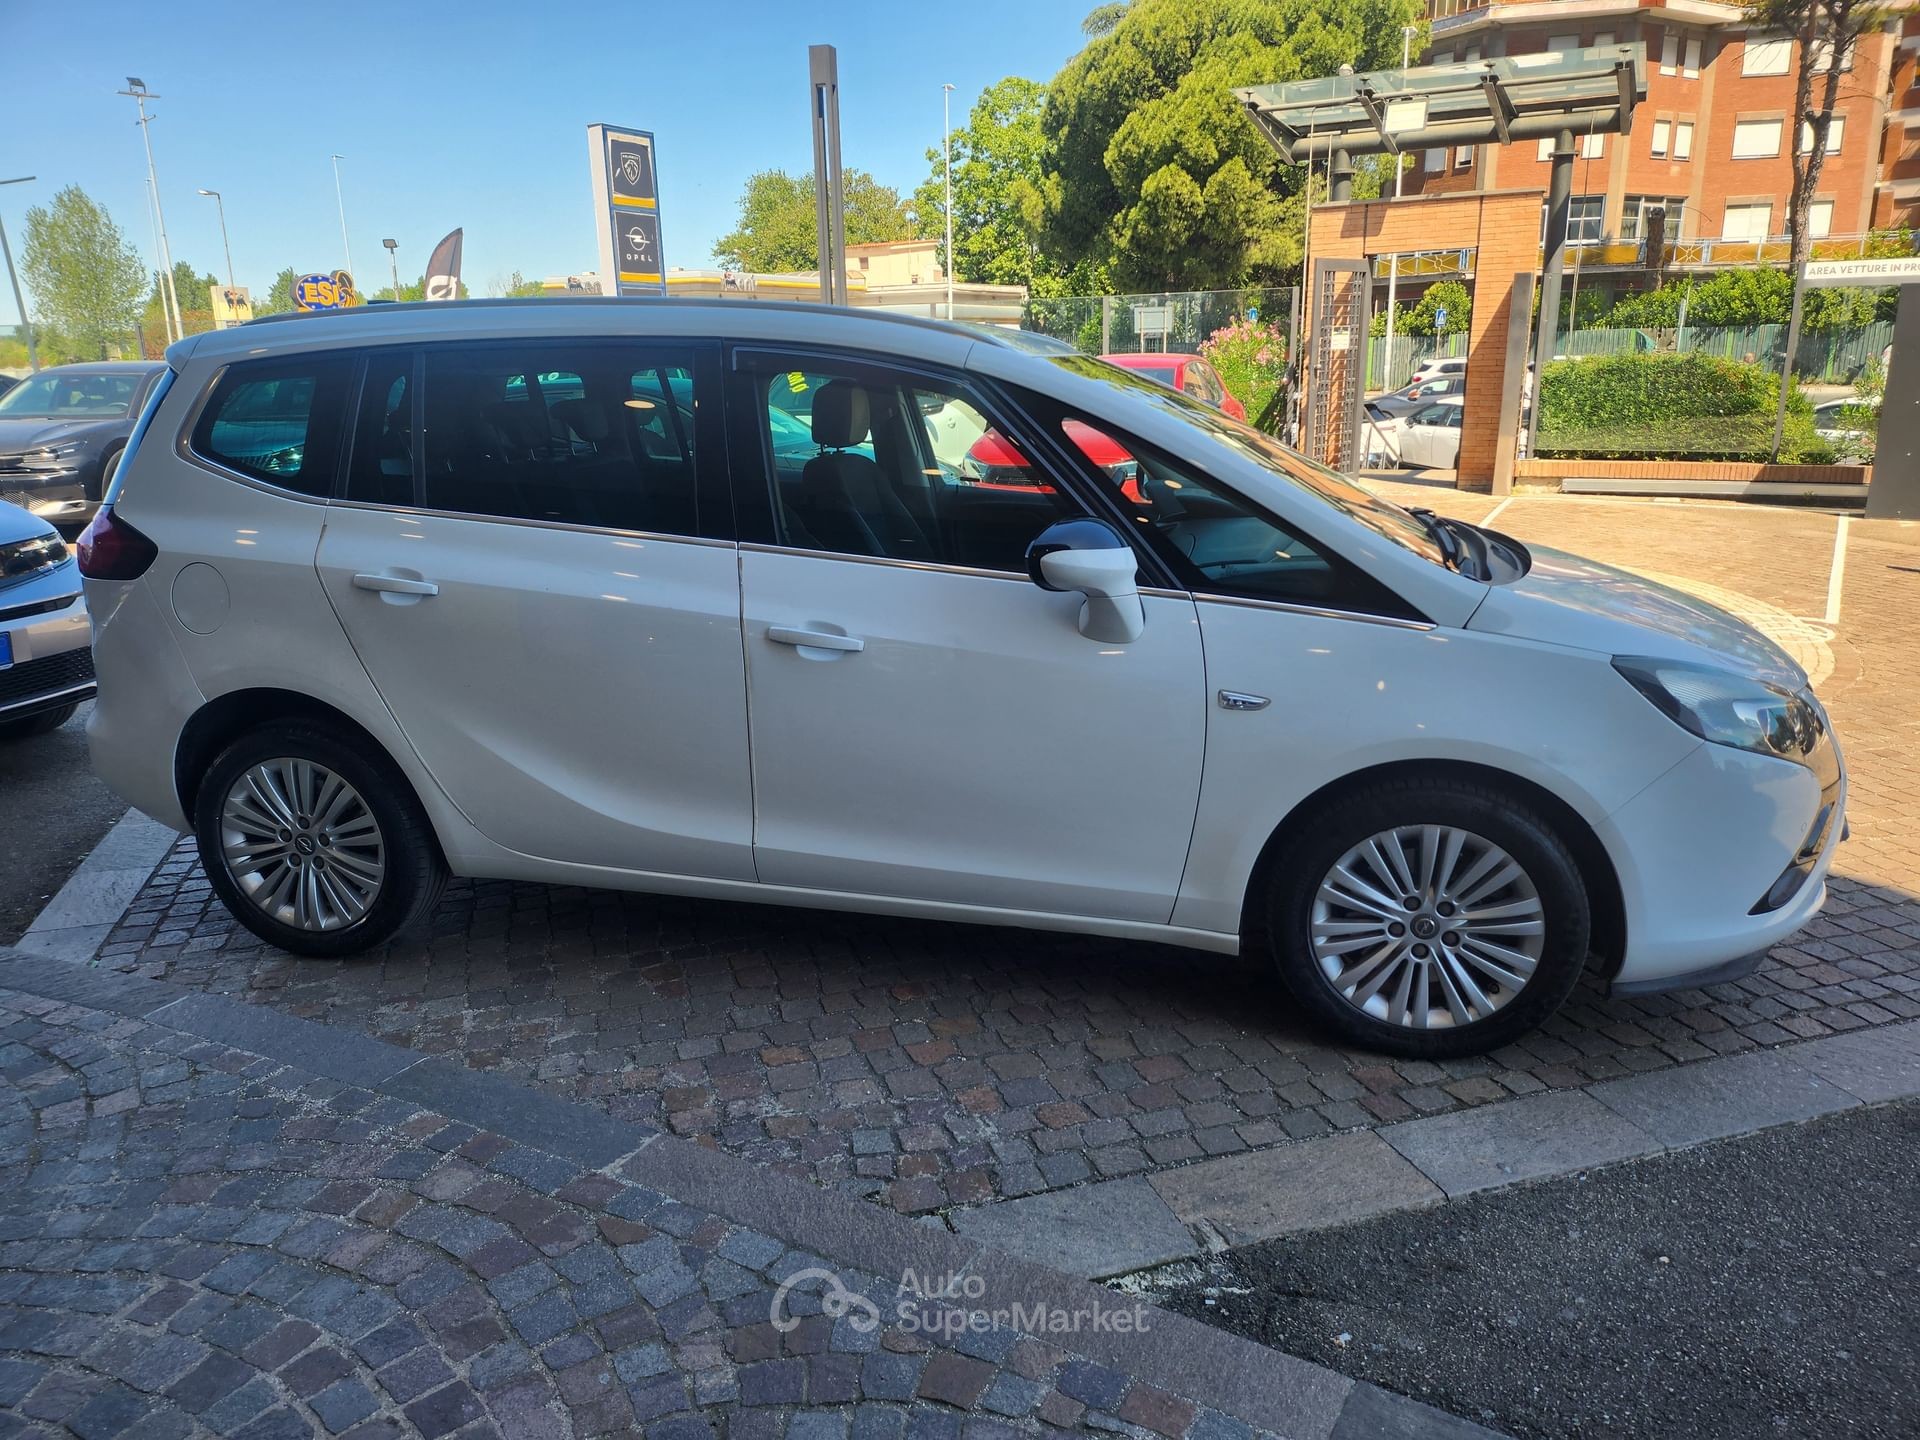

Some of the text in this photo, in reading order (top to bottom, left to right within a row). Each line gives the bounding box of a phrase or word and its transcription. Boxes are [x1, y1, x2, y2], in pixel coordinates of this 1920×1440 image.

[626, 253, 652, 262] OPEL
[1808, 265, 1837, 276] AREA
[1840, 263, 1888, 274] VETTURE
[1890, 263, 1902, 273] IN
